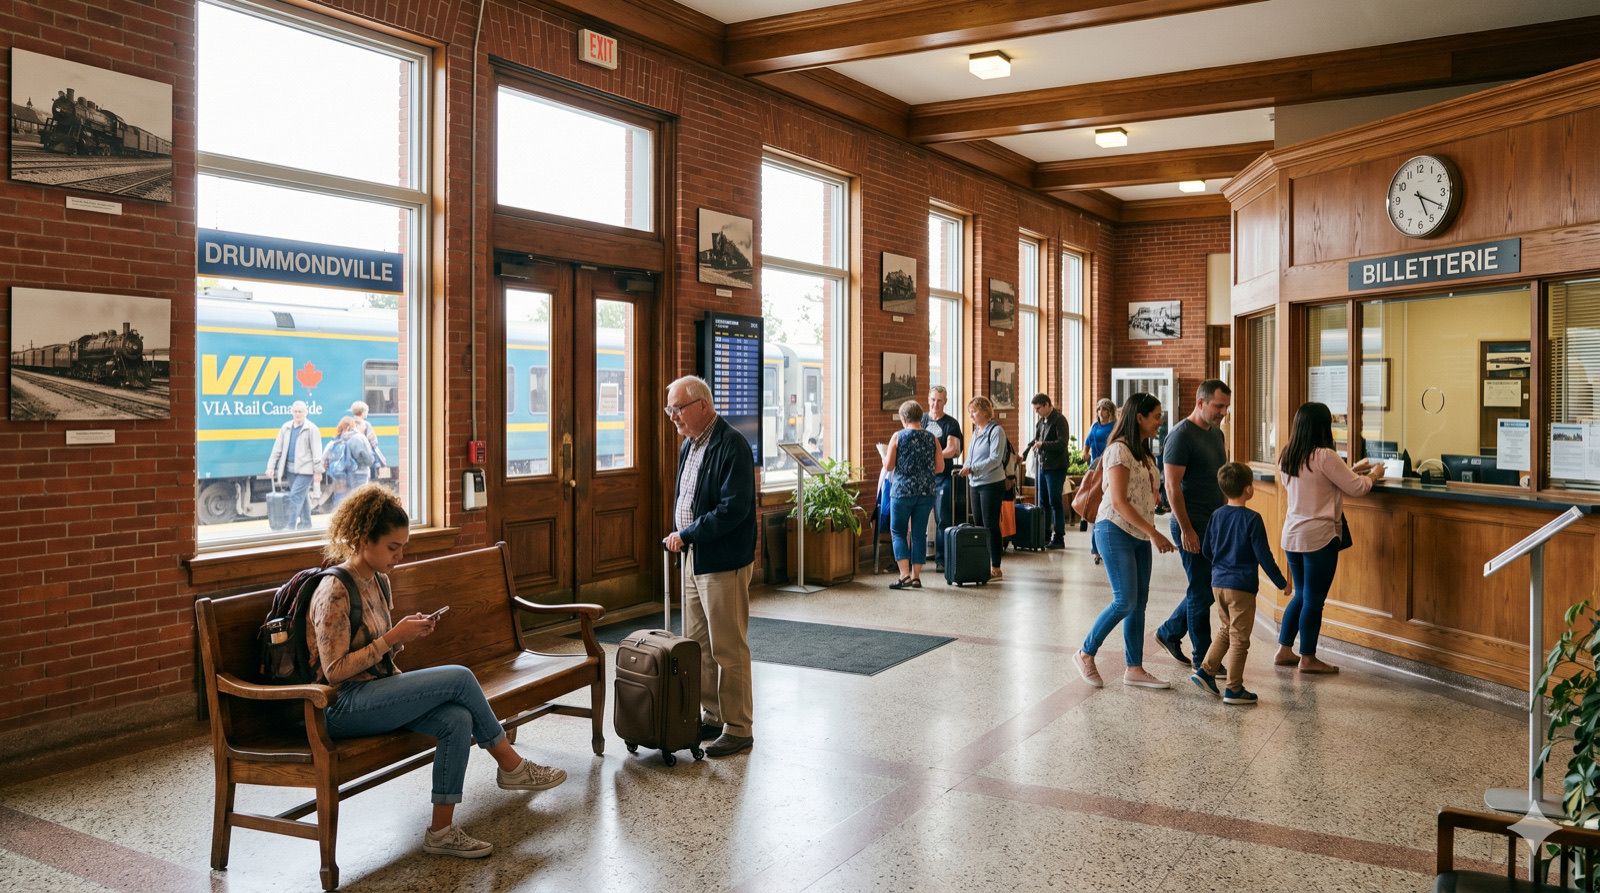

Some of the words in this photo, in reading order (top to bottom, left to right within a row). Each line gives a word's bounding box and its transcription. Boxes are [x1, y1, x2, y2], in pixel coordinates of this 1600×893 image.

[590, 33, 613, 63] EXIT
[1416, 164, 1424, 174] 12
[1407, 171, 1413, 180] 11
[1436, 174, 1442, 183] 2
[1399, 182, 1407, 192] 10
[1440, 187, 1446, 197] 3
[1395, 197, 1401, 205] 9
[1398, 209, 1404, 219] 8
[1428, 214, 1435, 223] 5
[1407, 218, 1413, 227] 7
[1417, 220, 1424, 230] 6
[205, 241, 393, 282] DRUMMONDVILLE
[1363, 246, 1498, 285] BILLETTERIE
[201, 354, 294, 396] VIA
[202, 401, 232, 416] VIA
[234, 400, 260, 416] Rail
